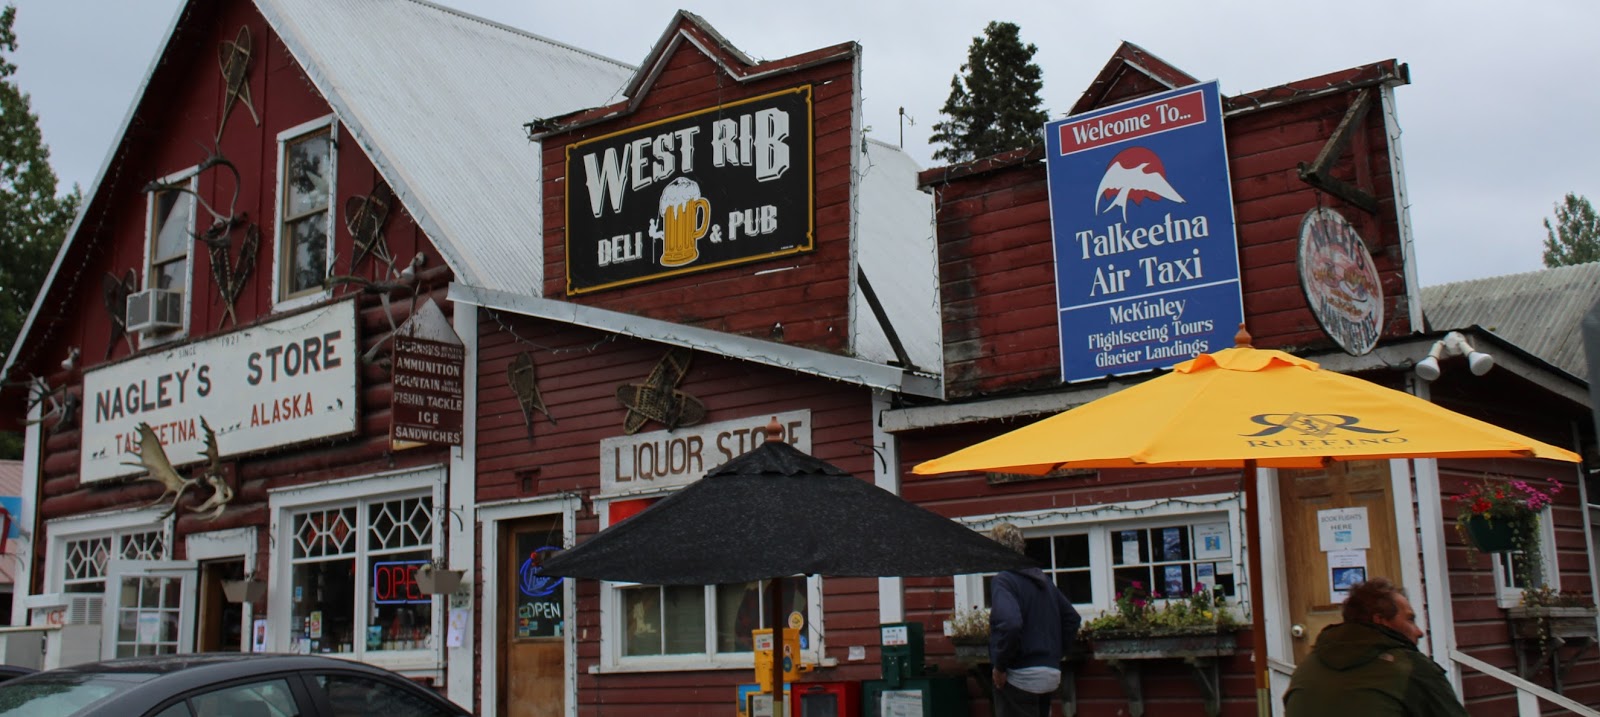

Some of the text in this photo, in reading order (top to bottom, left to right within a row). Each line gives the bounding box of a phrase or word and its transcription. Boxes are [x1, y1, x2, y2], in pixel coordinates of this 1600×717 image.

[1072, 103, 1191, 145] Welcome To...
[583, 107, 790, 218] WEST RIB
[597, 204, 778, 267] DELI & PUB
[1075, 213, 1209, 260] Talkeetna
[1090, 248, 1203, 297] Air Taxi
[1109, 298, 1186, 325] McKinley
[221, 335, 239, 348] 1921
[1088, 319, 1214, 351] Flightseeing Tours
[396, 357, 460, 377] AMMUNITION
[1095, 338, 1209, 368] Glacier Landings
[95, 330, 342, 424] NAGLEY'S STORE
[395, 374, 440, 391] FOUNTAIN
[418, 411, 439, 424] ICE
[427, 396, 462, 411] TACKLE
[115, 392, 314, 455] TALETNA ALASKA
[395, 426, 461, 444] SANDWICHES
[615, 421, 802, 483] LIQUOR STOE
[1247, 437, 1408, 448] RUFFINO
[376, 566, 432, 600] OPE
[47, 609, 65, 625] ICE
[527, 601, 561, 619] OPEN
